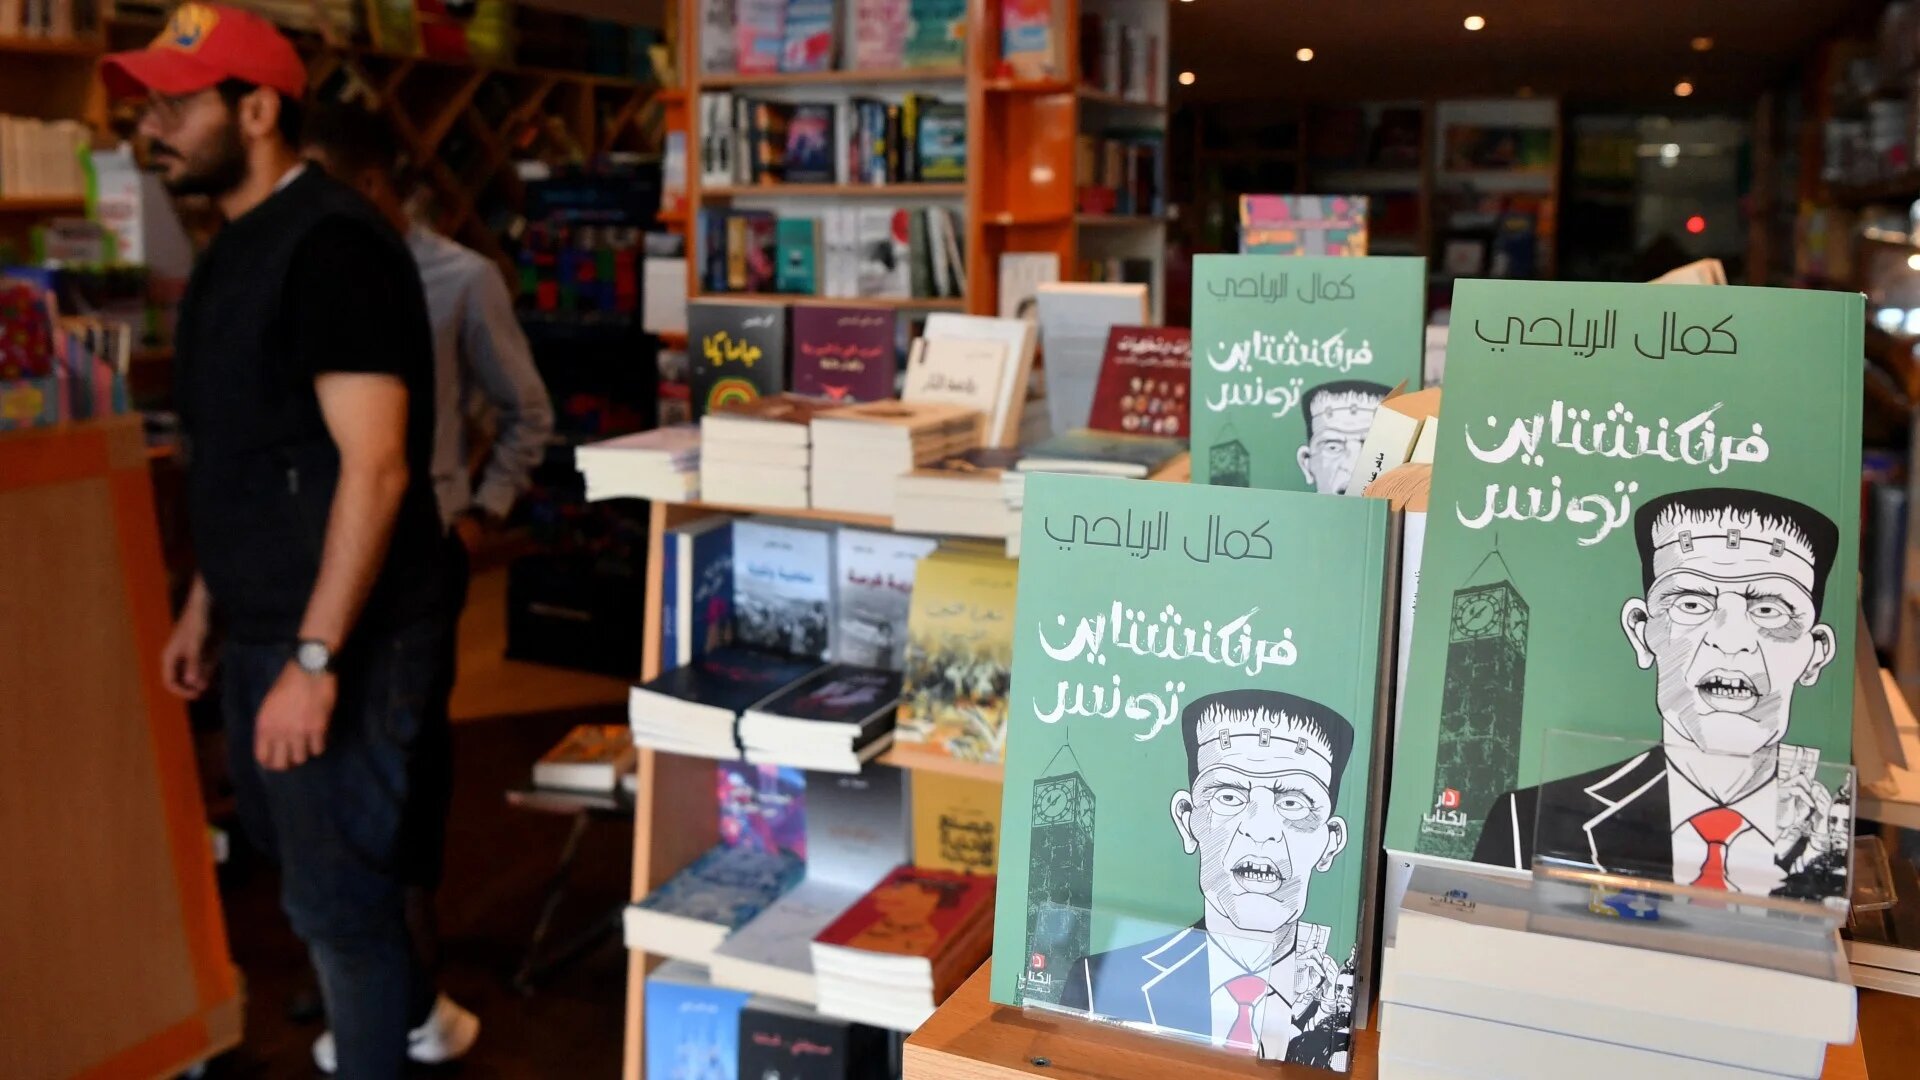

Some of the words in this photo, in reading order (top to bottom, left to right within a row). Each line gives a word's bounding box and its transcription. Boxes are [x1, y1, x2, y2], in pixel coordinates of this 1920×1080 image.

[1207, 272, 1289, 305] الرياحي
[1297, 272, 1356, 304] كمال
[1207, 328, 1374, 373] فرنكنشتاين
[1475, 308, 1617, 359] الرياحي
[1634, 311, 1738, 360] كمال
[1206, 377, 1304, 418] تونس
[1464, 400, 1770, 475] فرنكنشتاين
[1044, 508, 1169, 560] الرياحي
[1456, 475, 1639, 547] تونس
[1183, 514, 1273, 563] كمال
[1038, 600, 1298, 677] فرنكنشتاين
[1033, 674, 1186, 742] تونس
[1423, 809, 1468, 828] الكتاب
[1435, 790, 1456, 808] دار
